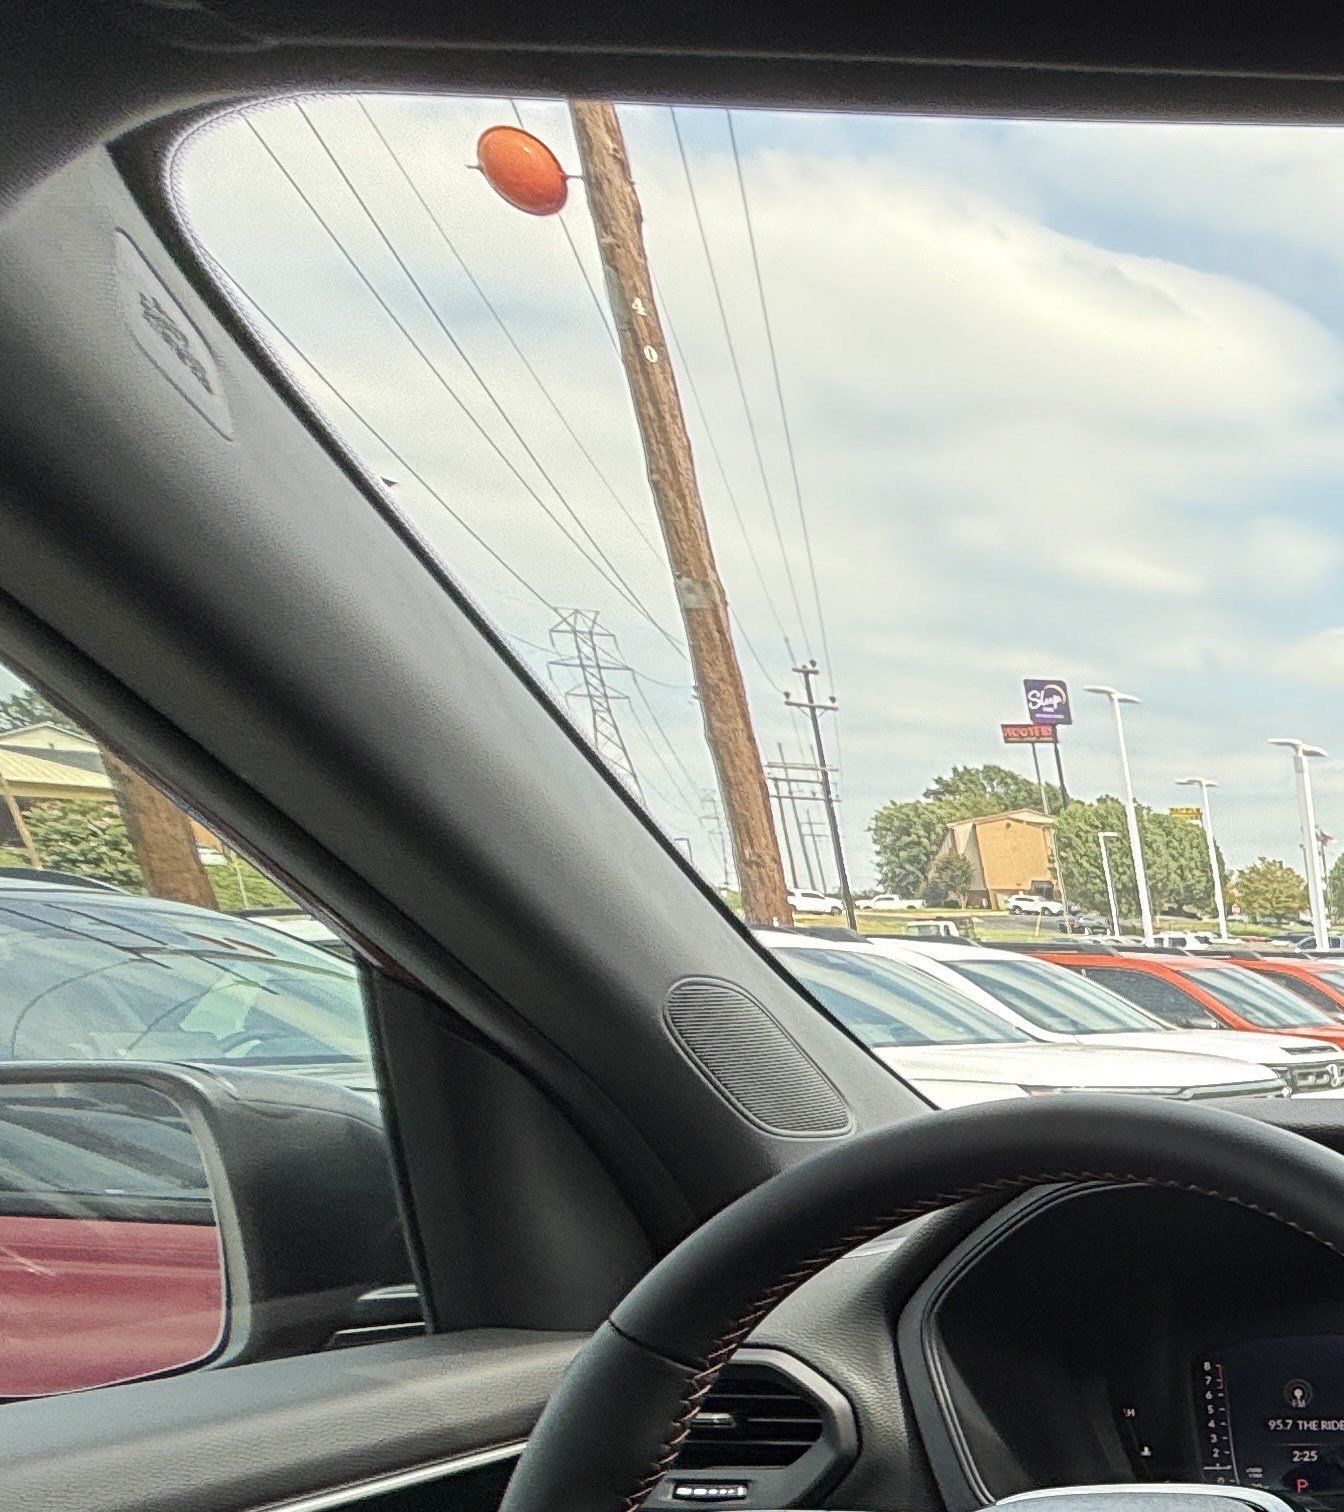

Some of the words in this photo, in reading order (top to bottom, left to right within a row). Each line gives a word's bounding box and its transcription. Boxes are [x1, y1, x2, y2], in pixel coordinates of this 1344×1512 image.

[1268, 1420, 1292, 1430] 95.7
[1297, 1420, 1319, 1431] THE
[1292, 1451, 1318, 1462] 2:25
[1296, 1479, 1309, 1493] P
